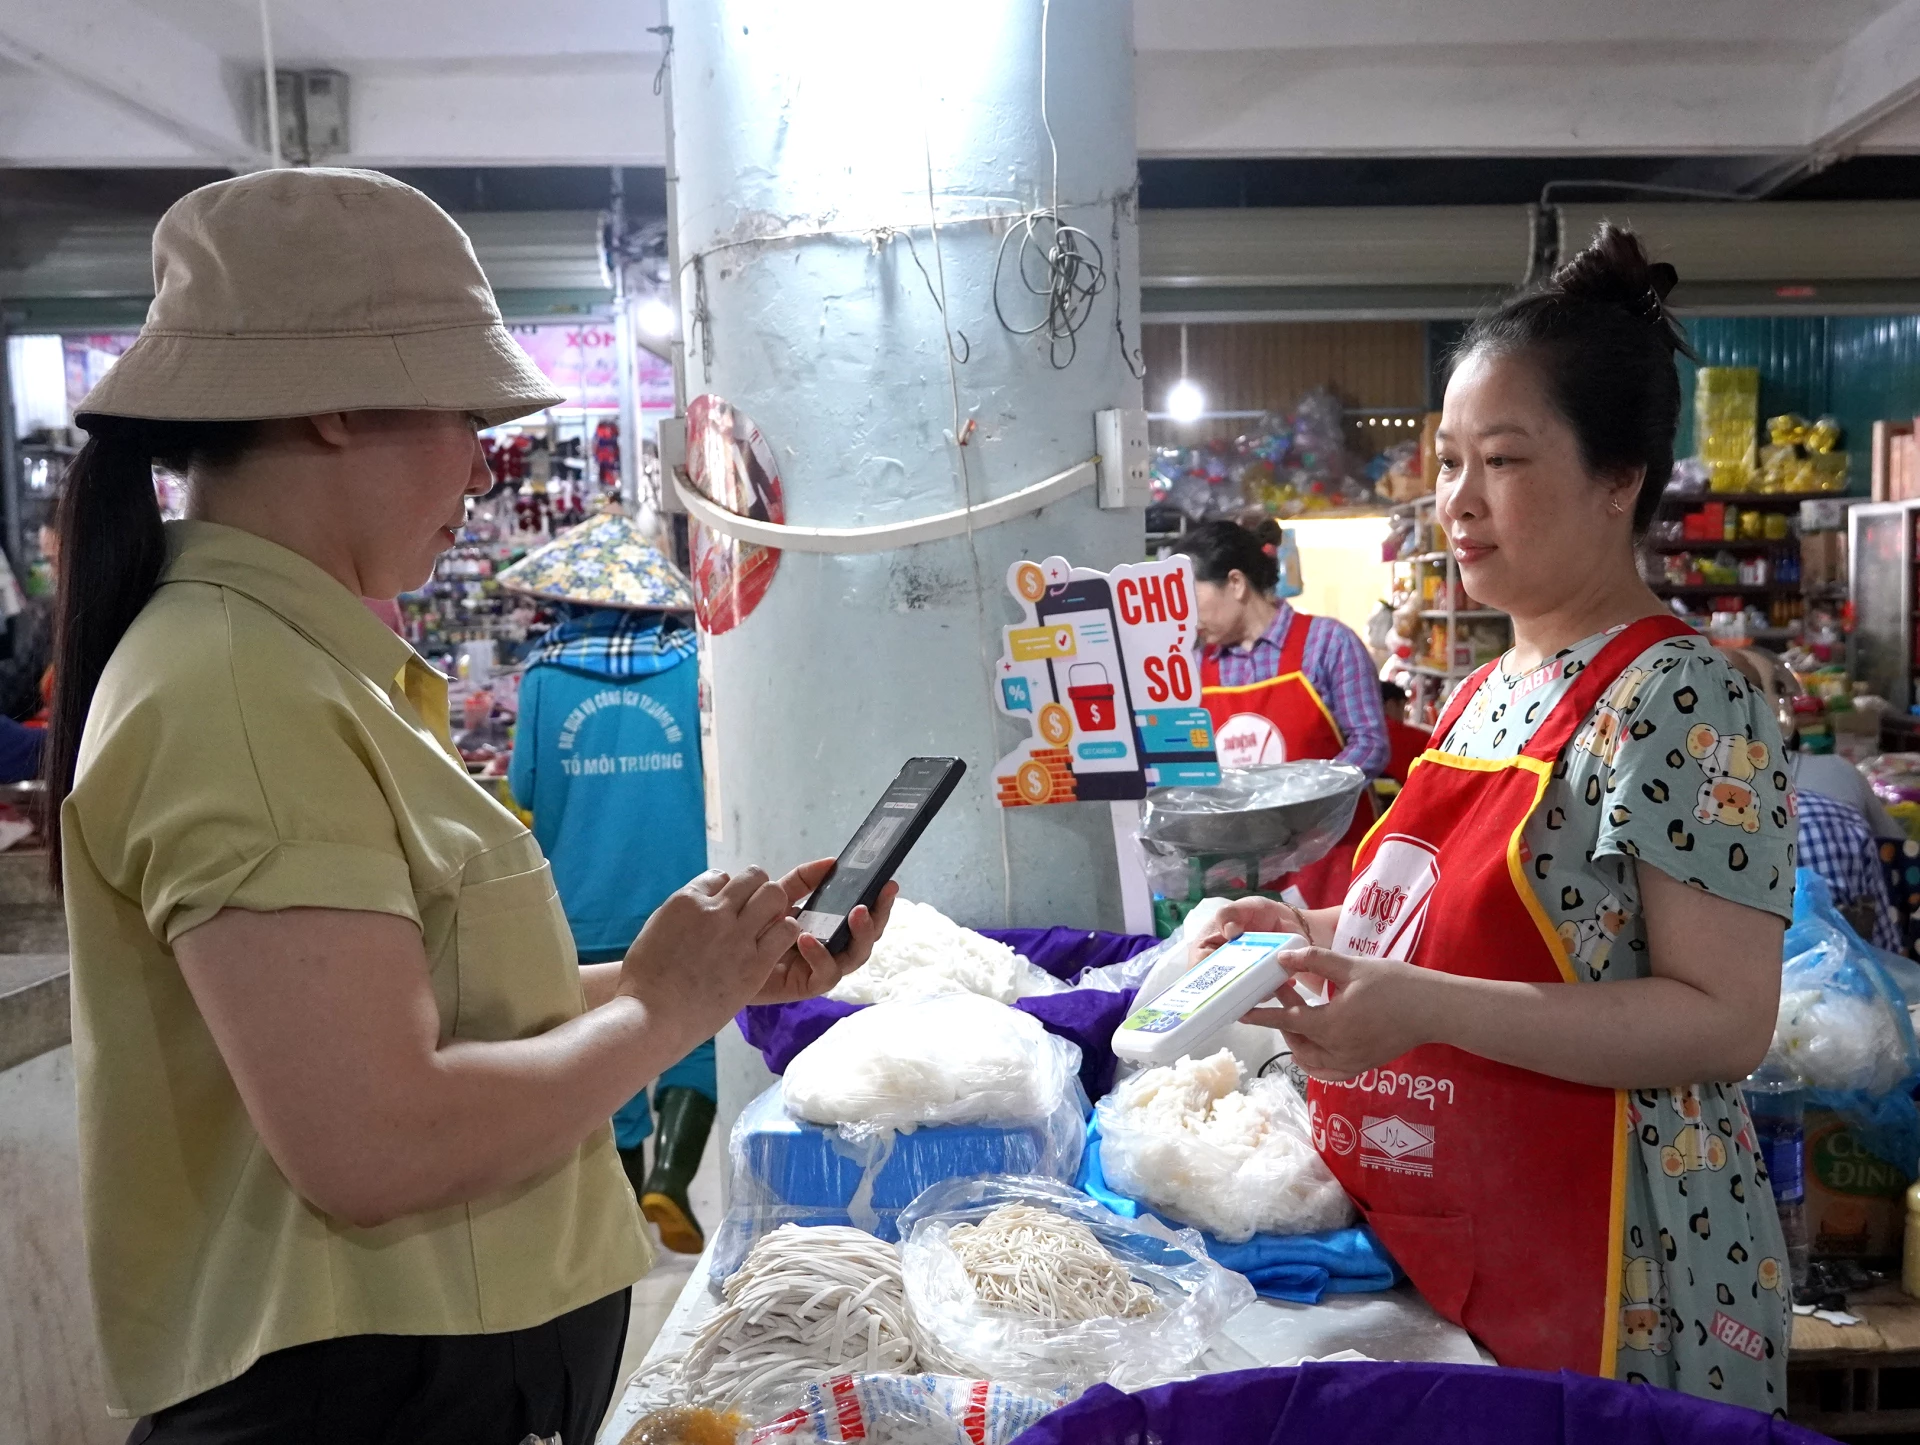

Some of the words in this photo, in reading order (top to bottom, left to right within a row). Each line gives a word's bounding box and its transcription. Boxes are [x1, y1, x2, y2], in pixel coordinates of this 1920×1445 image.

[1117, 568, 1189, 632] CHỢ
[1143, 637, 1193, 703] SỐ
[1513, 661, 1557, 702] BABY
[561, 751, 581, 775] TỔ
[584, 753, 615, 775] MÔI
